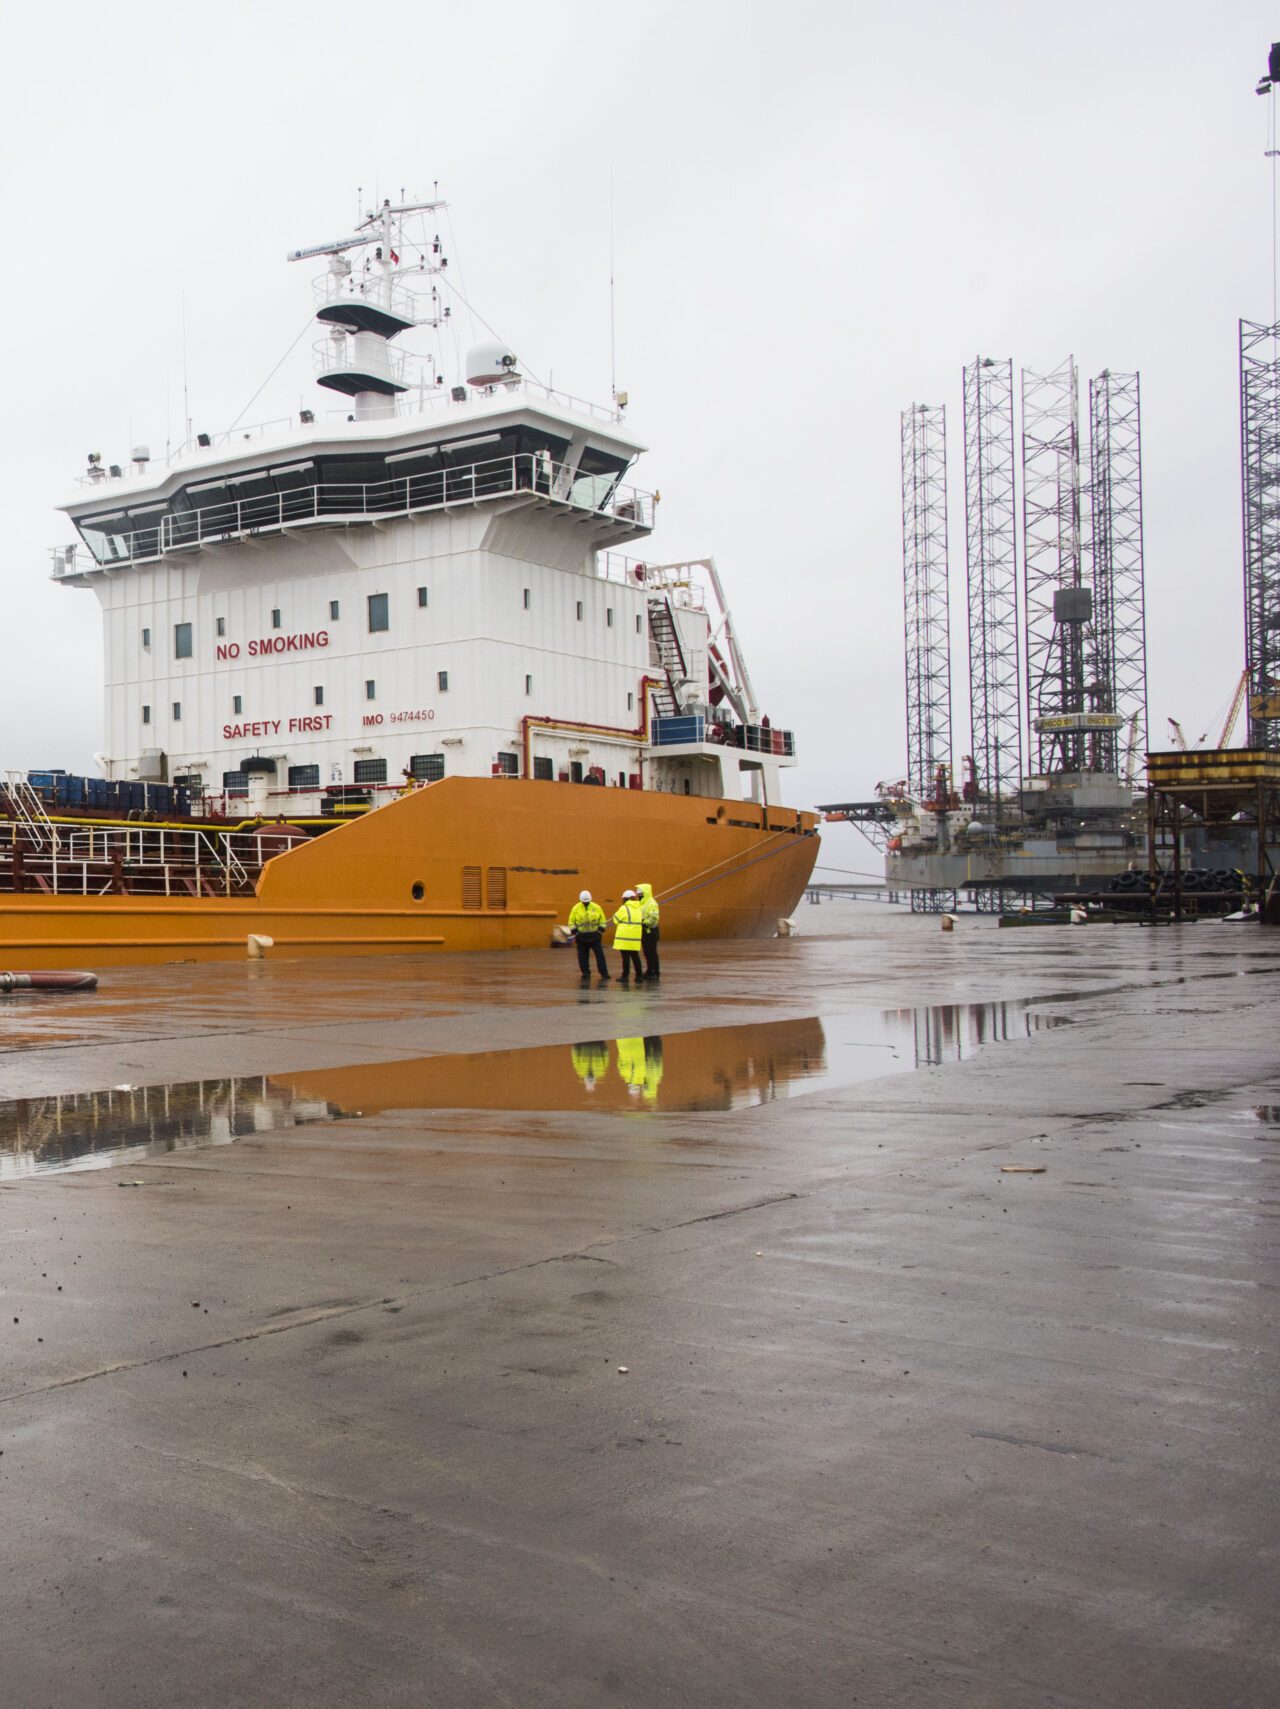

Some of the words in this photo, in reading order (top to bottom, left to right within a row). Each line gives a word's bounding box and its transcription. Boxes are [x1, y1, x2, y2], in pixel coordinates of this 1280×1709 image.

[216, 643, 240, 660] NO
[248, 631, 329, 656] SMOKING
[223, 719, 281, 739] SAFETY
[289, 715, 333, 733] FIRST
[363, 714, 384, 726] IMO
[390, 709, 435, 723] 9474450
[1041, 719, 1062, 727] ENSCO
